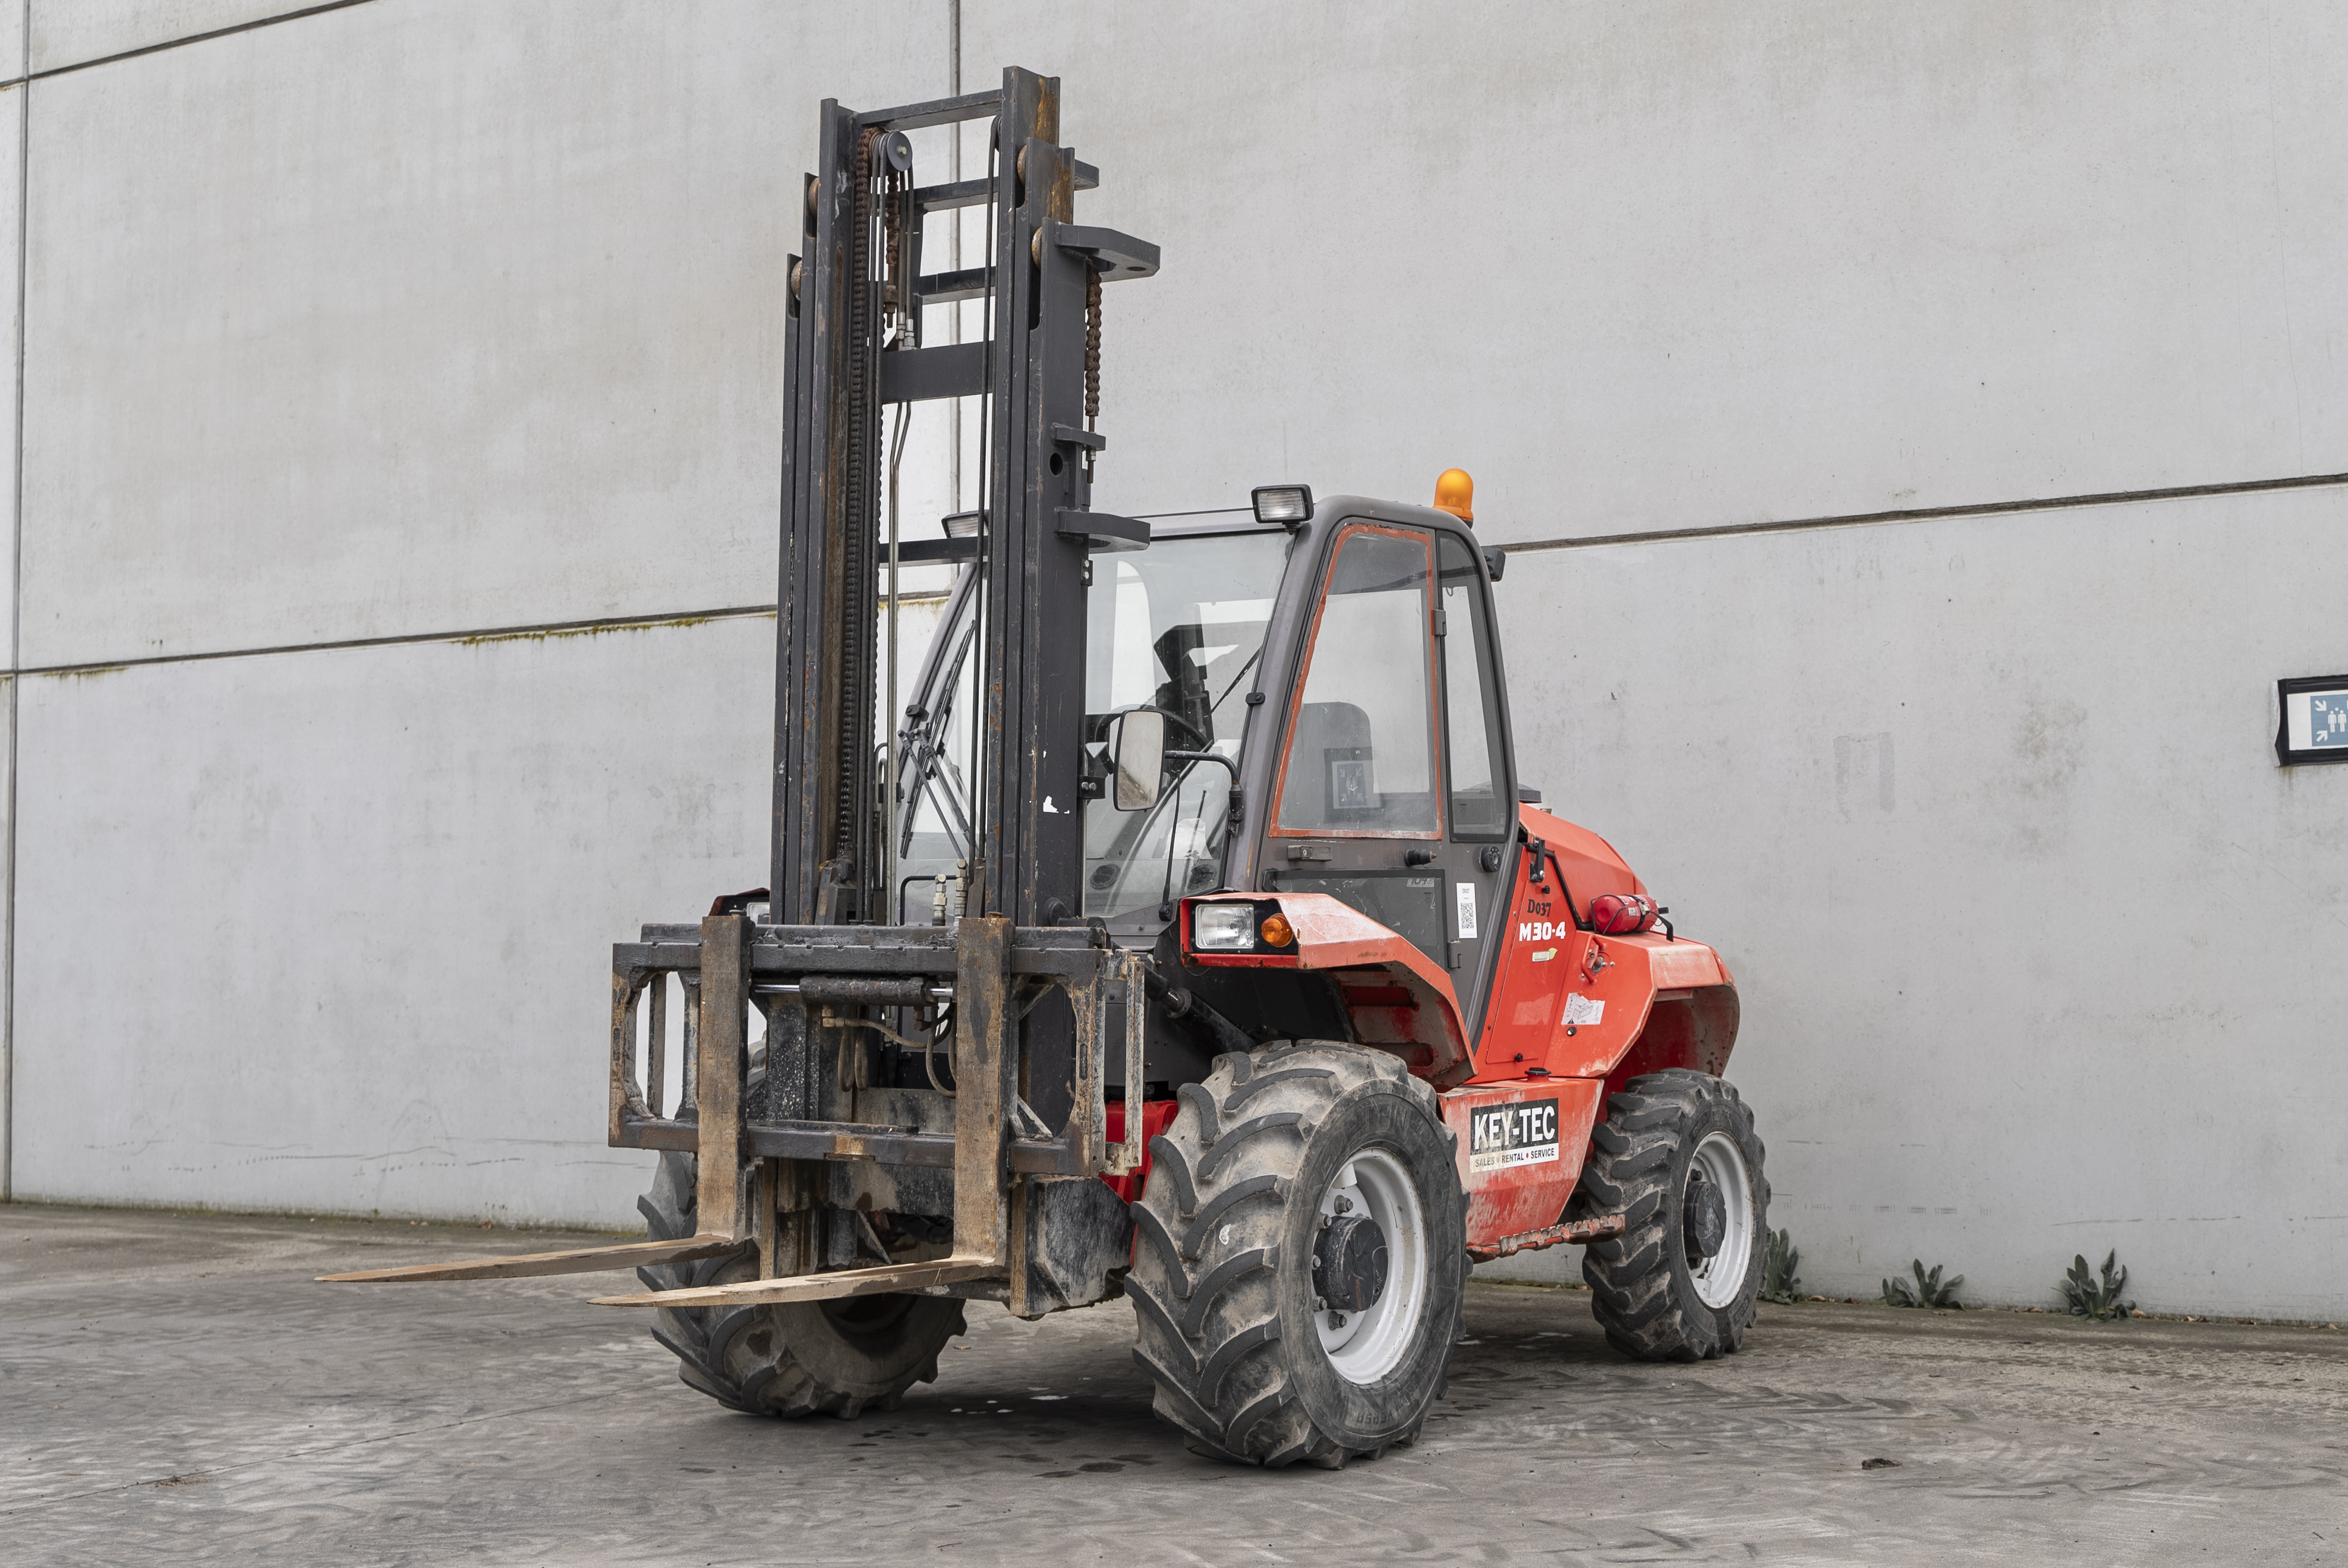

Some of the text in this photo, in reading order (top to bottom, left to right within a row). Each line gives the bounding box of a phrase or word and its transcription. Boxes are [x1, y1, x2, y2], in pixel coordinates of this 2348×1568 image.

[1527, 898, 1552, 917] D037
[1474, 1105, 1555, 1150] KEY-TEC
[1475, 1147, 1555, 1168] SALES RENTAL SERVICE
